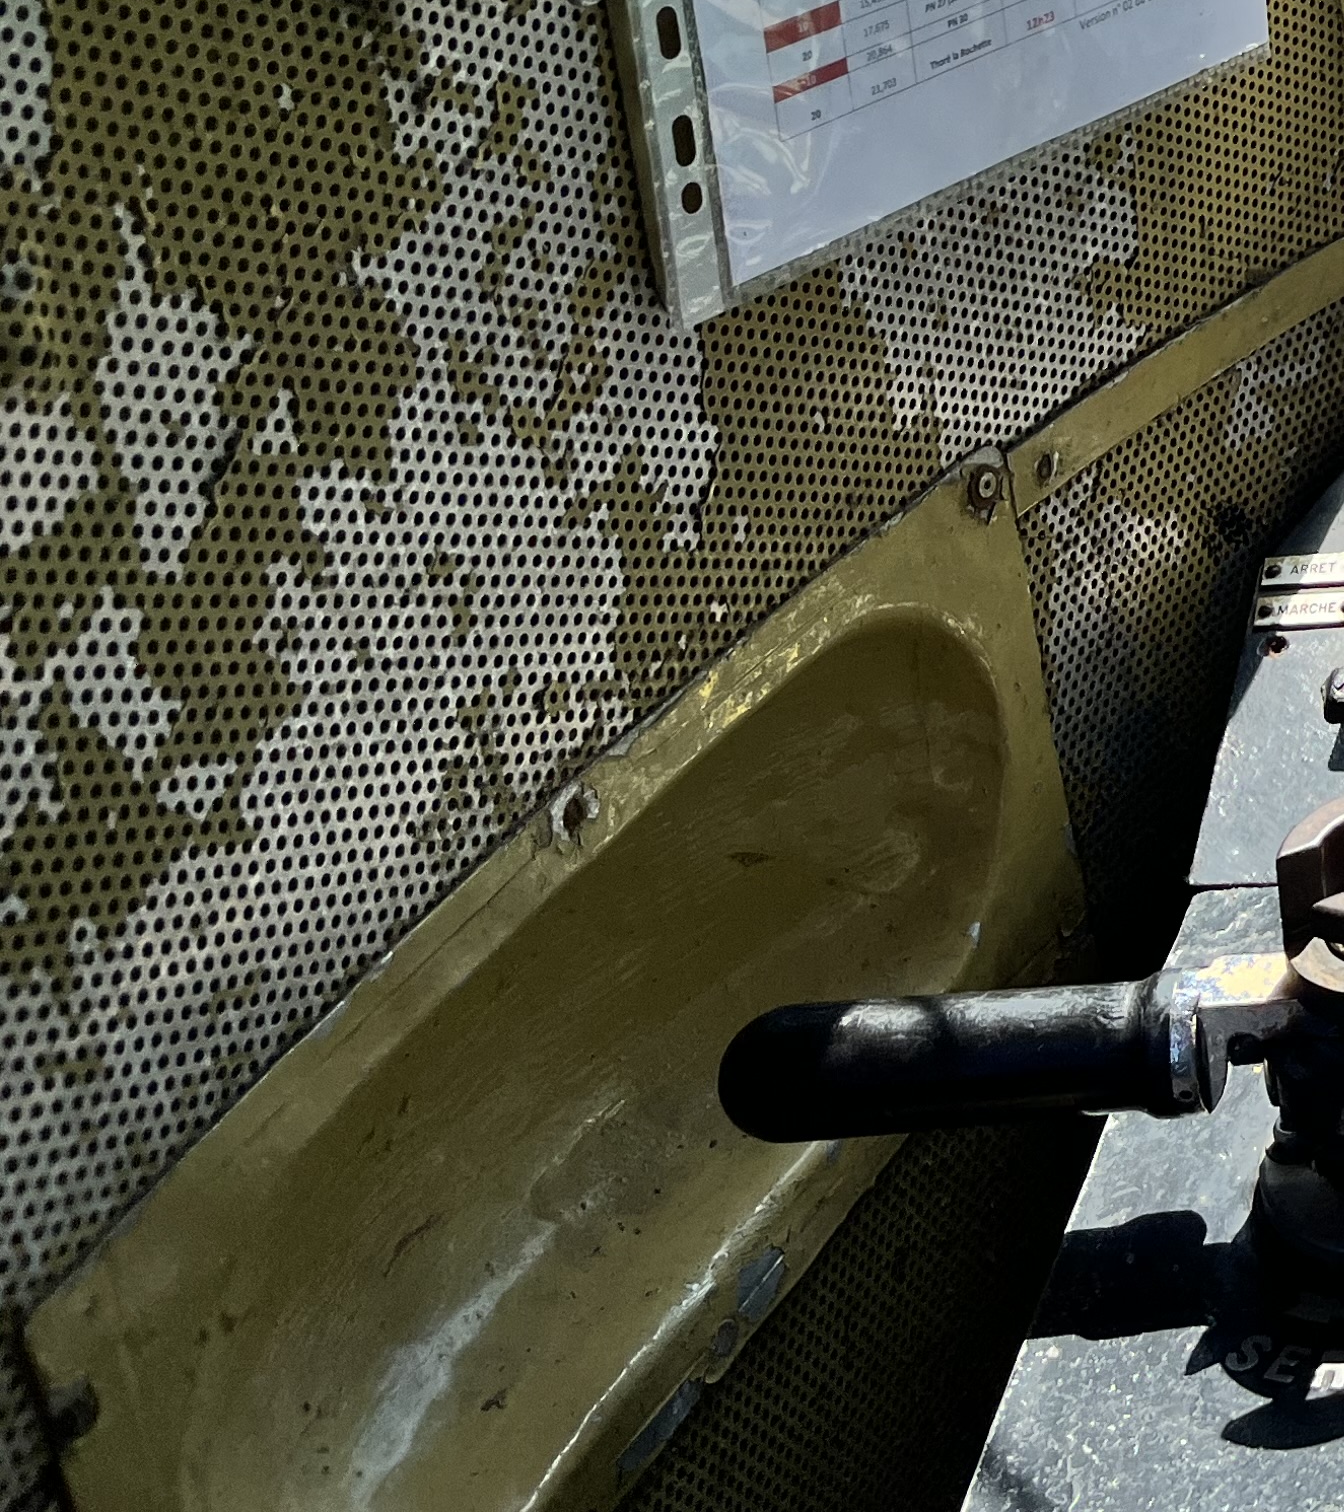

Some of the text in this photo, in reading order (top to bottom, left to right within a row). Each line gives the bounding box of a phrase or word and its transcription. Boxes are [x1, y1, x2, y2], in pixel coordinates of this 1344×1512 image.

[1079, 9, 1111, 30] Version
[1290, 561, 1336, 576] ARRET
[1271, 601, 1337, 616] MARCHE
